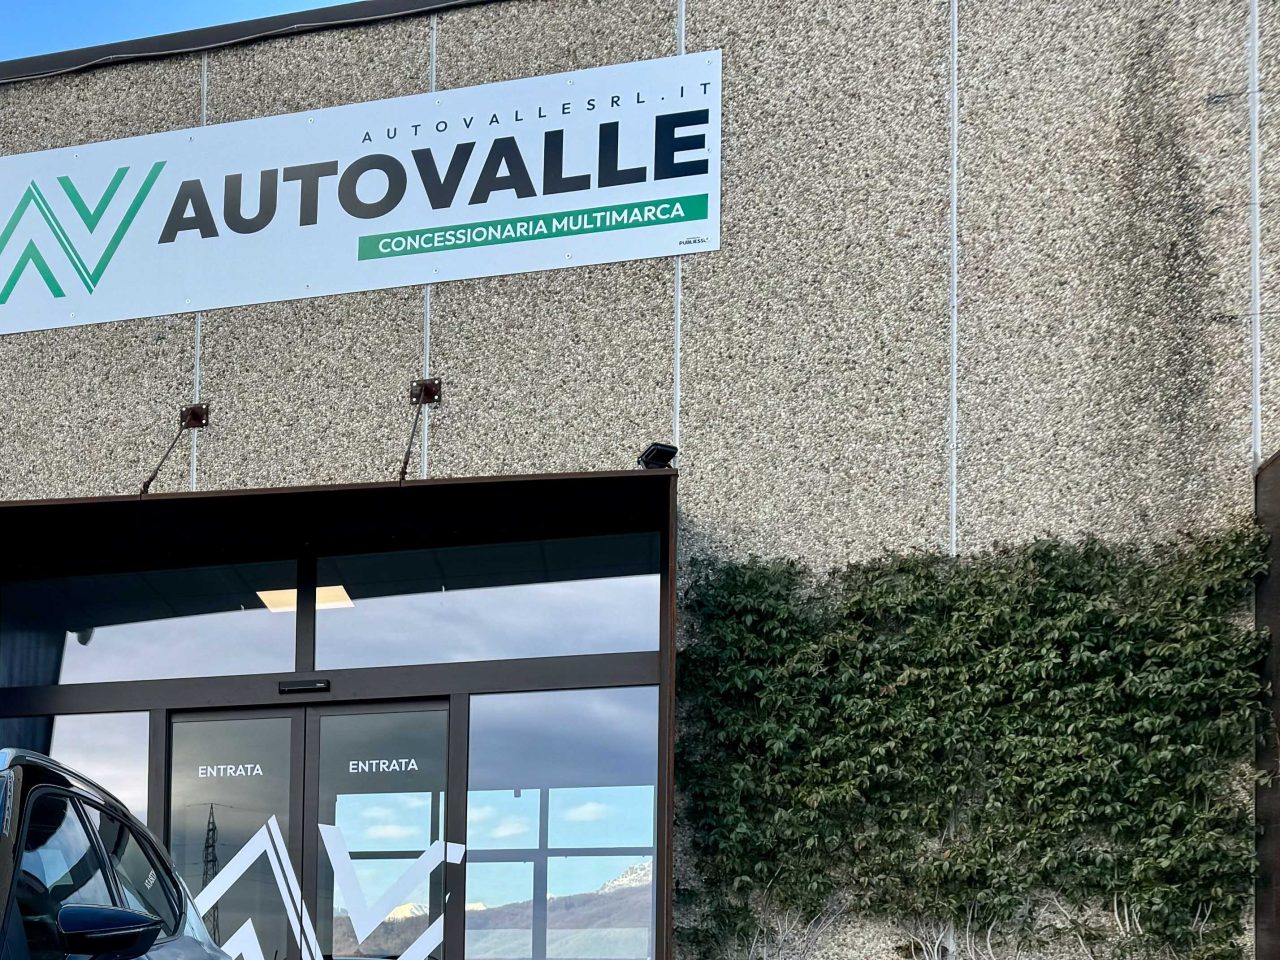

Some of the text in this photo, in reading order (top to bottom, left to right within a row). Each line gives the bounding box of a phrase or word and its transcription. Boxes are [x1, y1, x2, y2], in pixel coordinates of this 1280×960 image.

[361, 82, 711, 144] AUTOVALLESRL.IT
[157, 108, 710, 245] AUTOVALLE
[378, 202, 686, 254] CONCESSIONARIA MULTIMARCA
[198, 763, 263, 778] ENTRATA
[349, 758, 418, 773] ENTRATA
